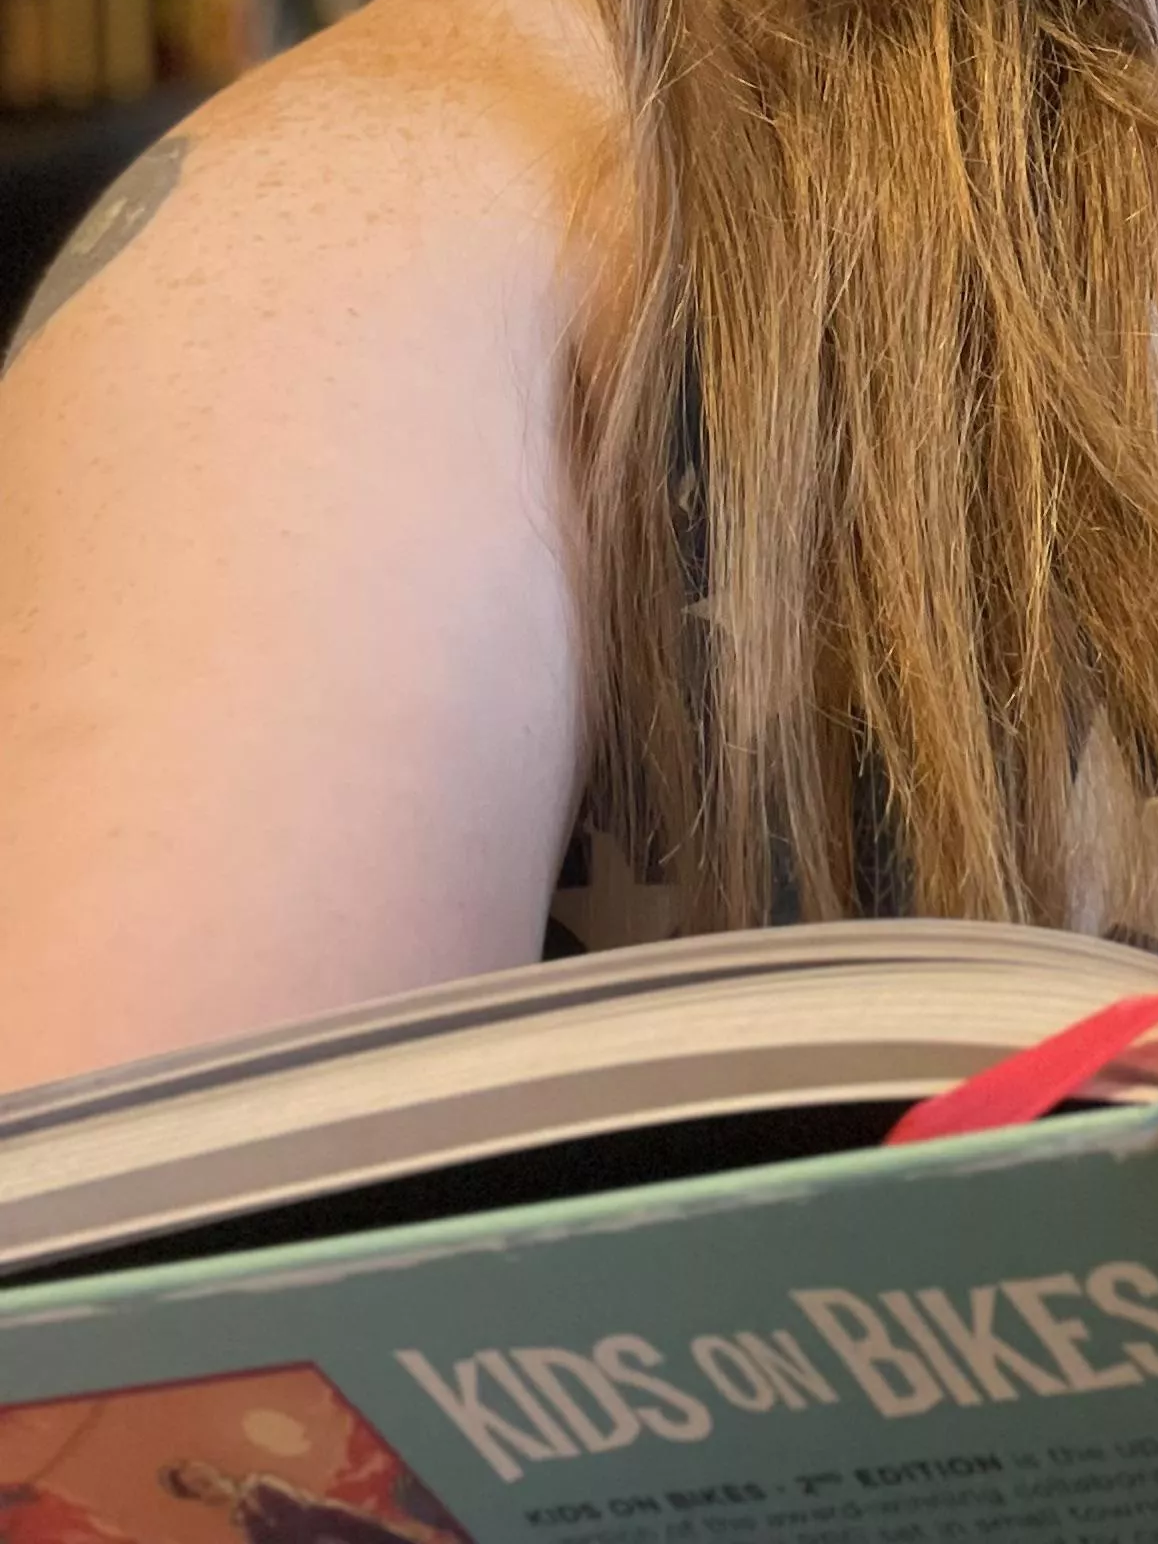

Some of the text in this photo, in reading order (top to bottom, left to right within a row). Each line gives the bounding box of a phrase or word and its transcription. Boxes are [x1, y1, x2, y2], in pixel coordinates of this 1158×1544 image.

[395, 1333, 713, 1483] KIDS
[691, 1329, 840, 1413] ON
[523, 1502, 602, 1529] KIDS
[607, 1495, 662, 1518] ON
[664, 1482, 768, 1512] BIKES
[853, 1453, 1004, 1490] EDITION
